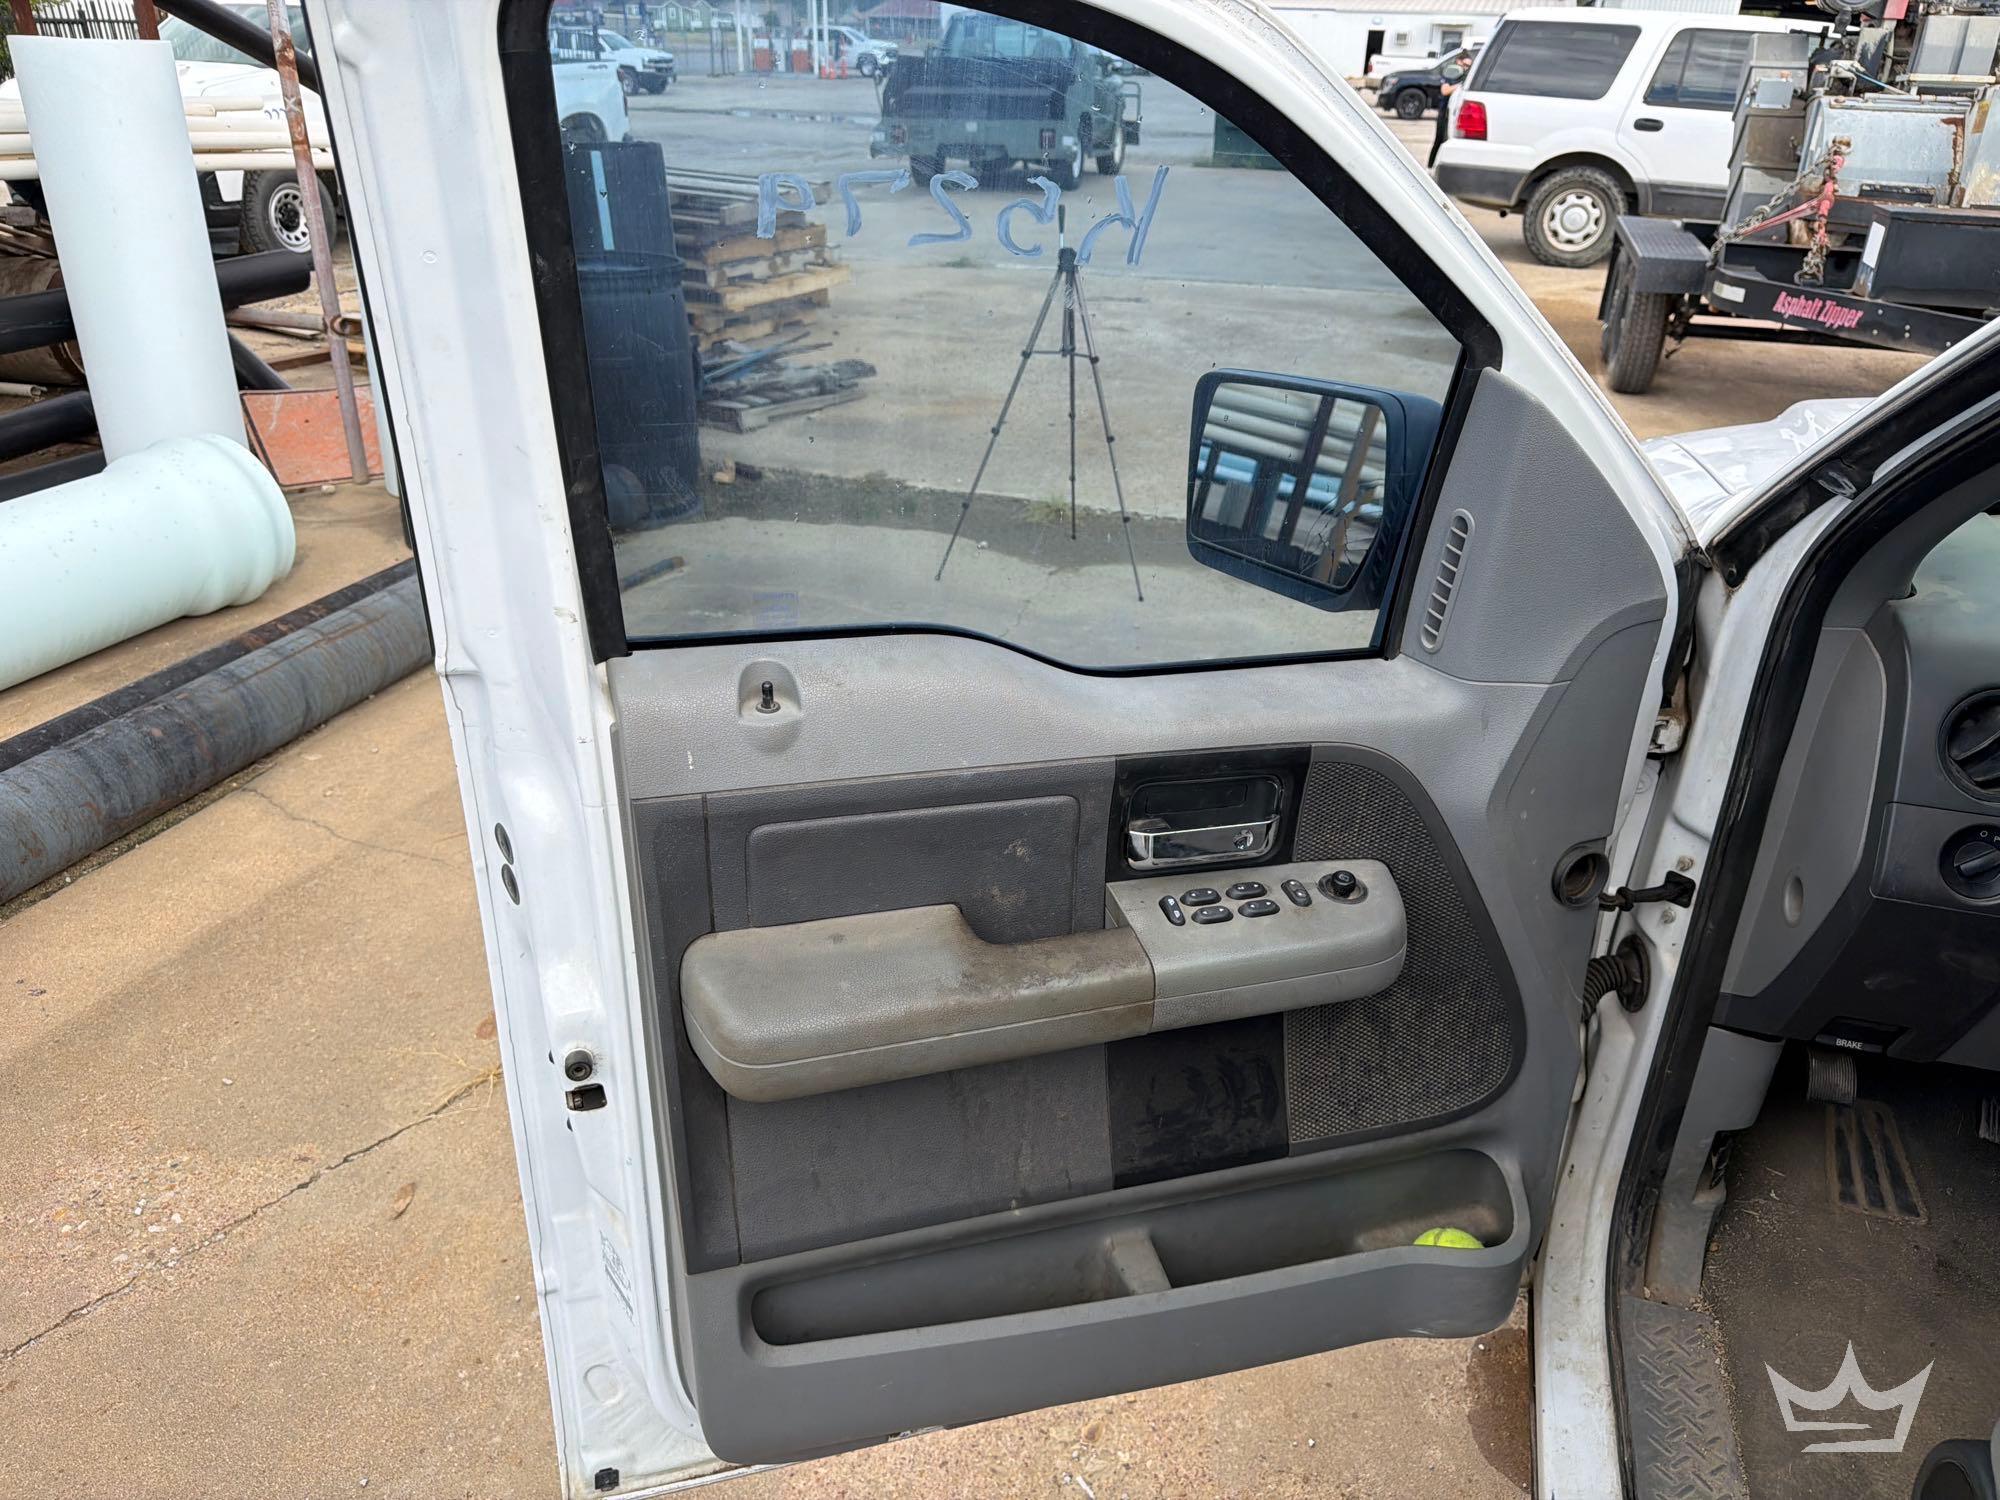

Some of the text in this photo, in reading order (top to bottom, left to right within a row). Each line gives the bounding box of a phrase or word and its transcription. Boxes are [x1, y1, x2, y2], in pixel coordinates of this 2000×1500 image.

[1772, 291, 1864, 330] Asphalt Zipper
[1836, 1038, 1864, 1050] BRAKE
